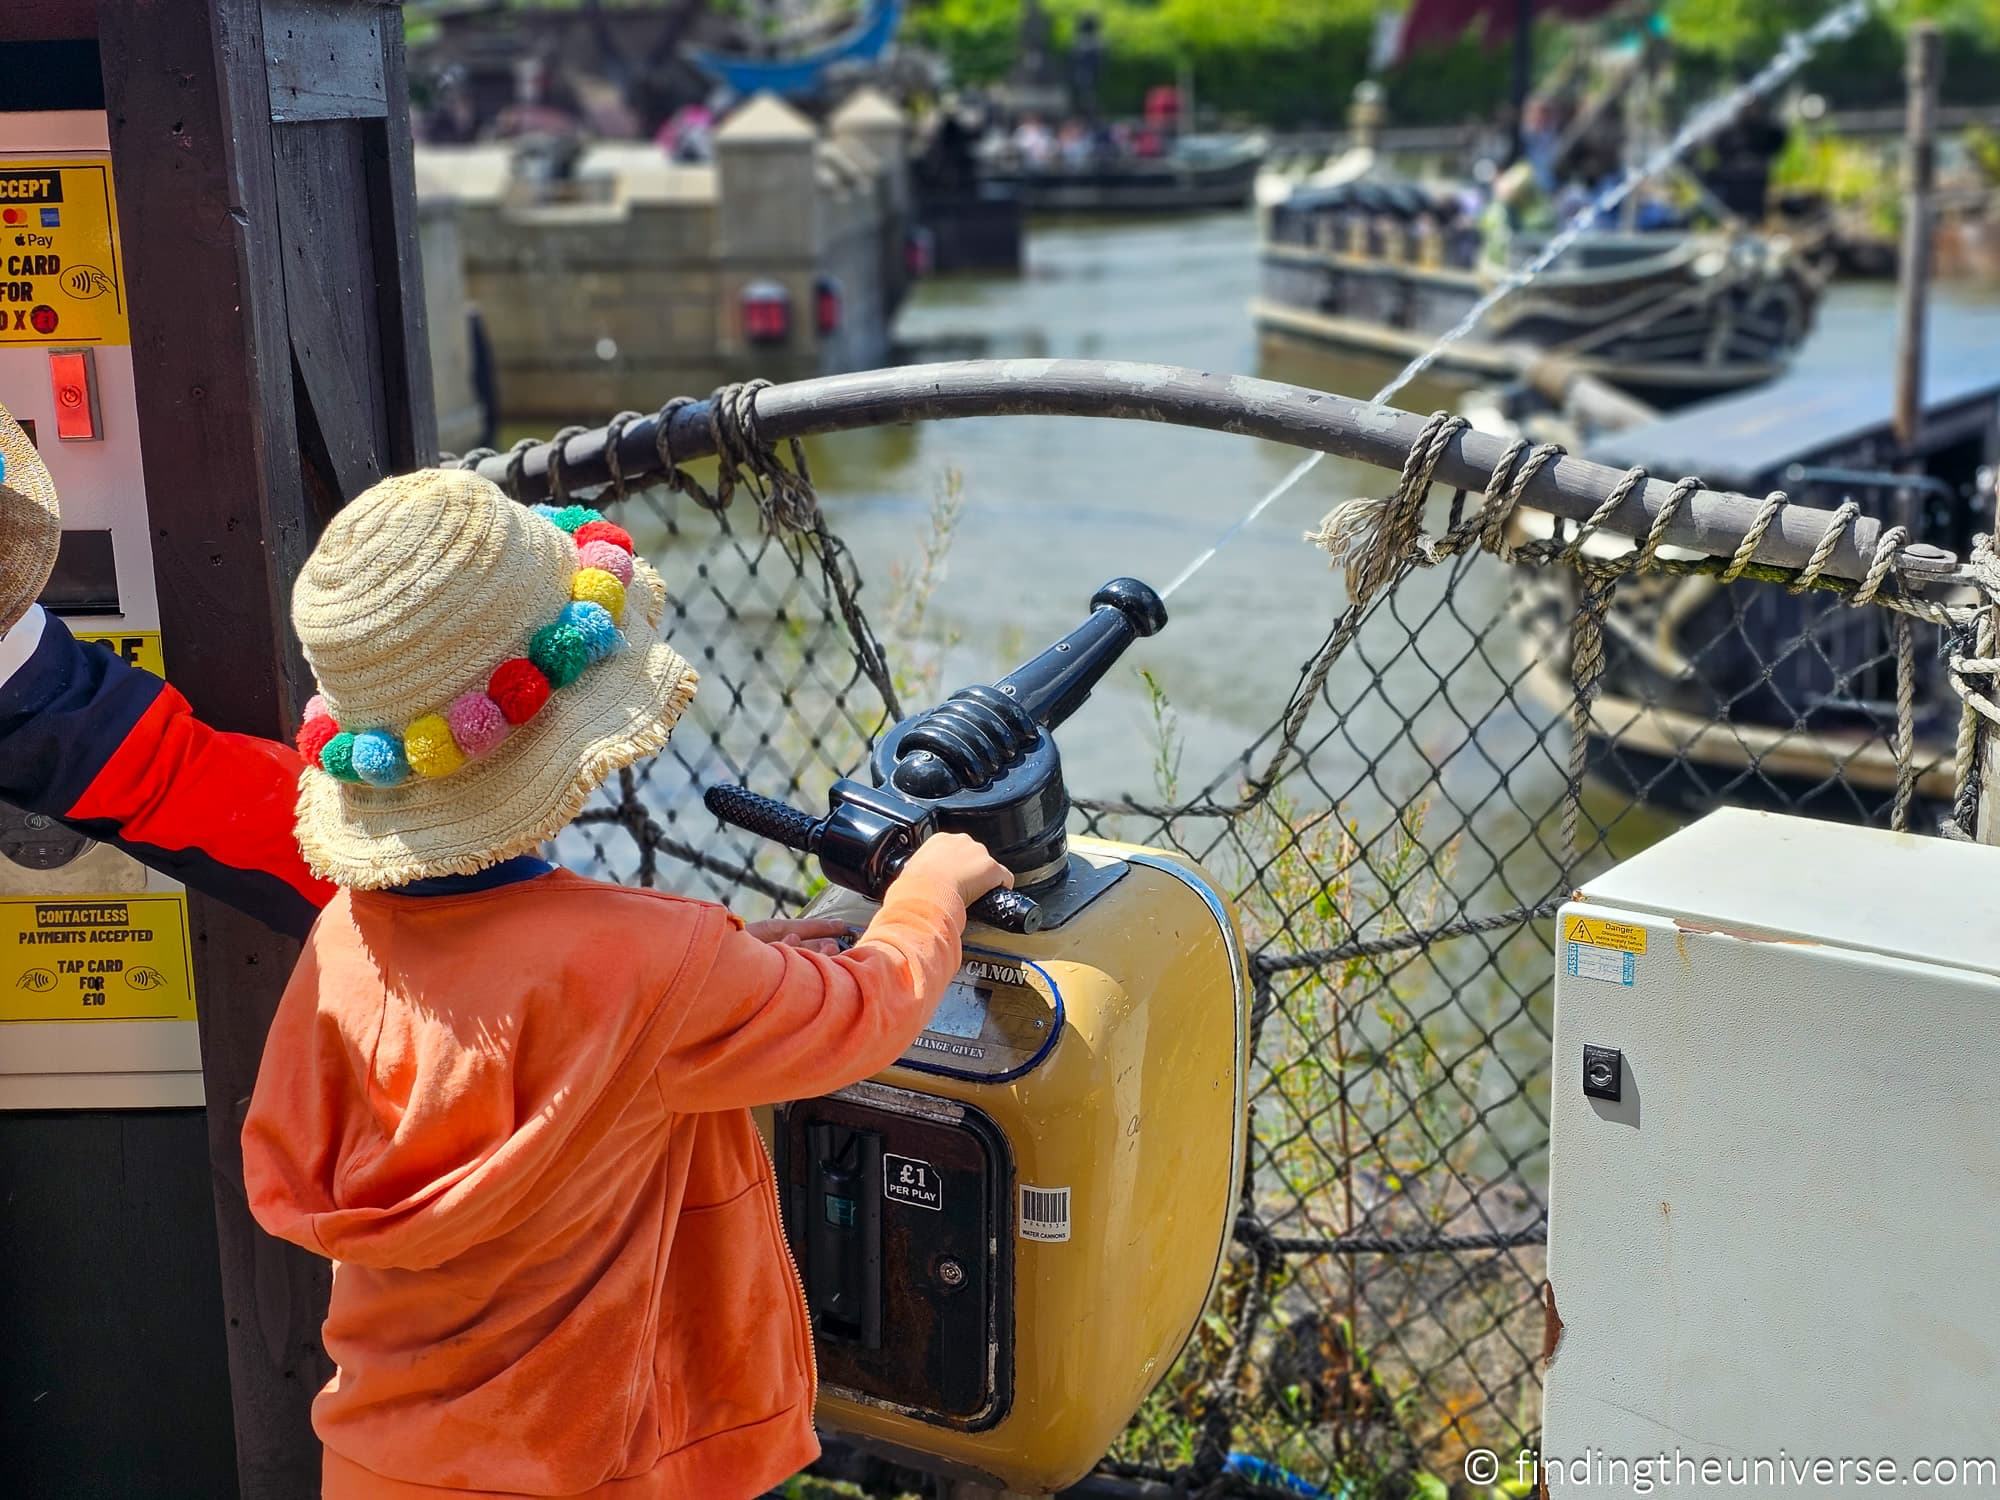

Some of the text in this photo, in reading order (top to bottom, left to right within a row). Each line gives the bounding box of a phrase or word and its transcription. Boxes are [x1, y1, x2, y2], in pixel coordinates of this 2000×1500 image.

[0, 179, 51, 199] CCEPT
[28, 233, 53, 249] Pay
[8, 254, 61, 276] CARD
[38, 909, 128, 924] CONTACTLESS
[19, 929, 154, 945] PAYMENTS ACCEPTED
[1605, 923, 1634, 934] Danger
[57, 959, 123, 974] TAP CARD
[1568, 944, 1577, 975] PASSED
[965, 960, 1028, 985] CANON
[79, 976, 105, 991] FOR
[82, 992, 106, 1006] £10
[912, 1036, 985, 1059] HANGE GIVEN
[900, 1164, 926, 1188] £1
[889, 1183, 937, 1202] PER PLAY
